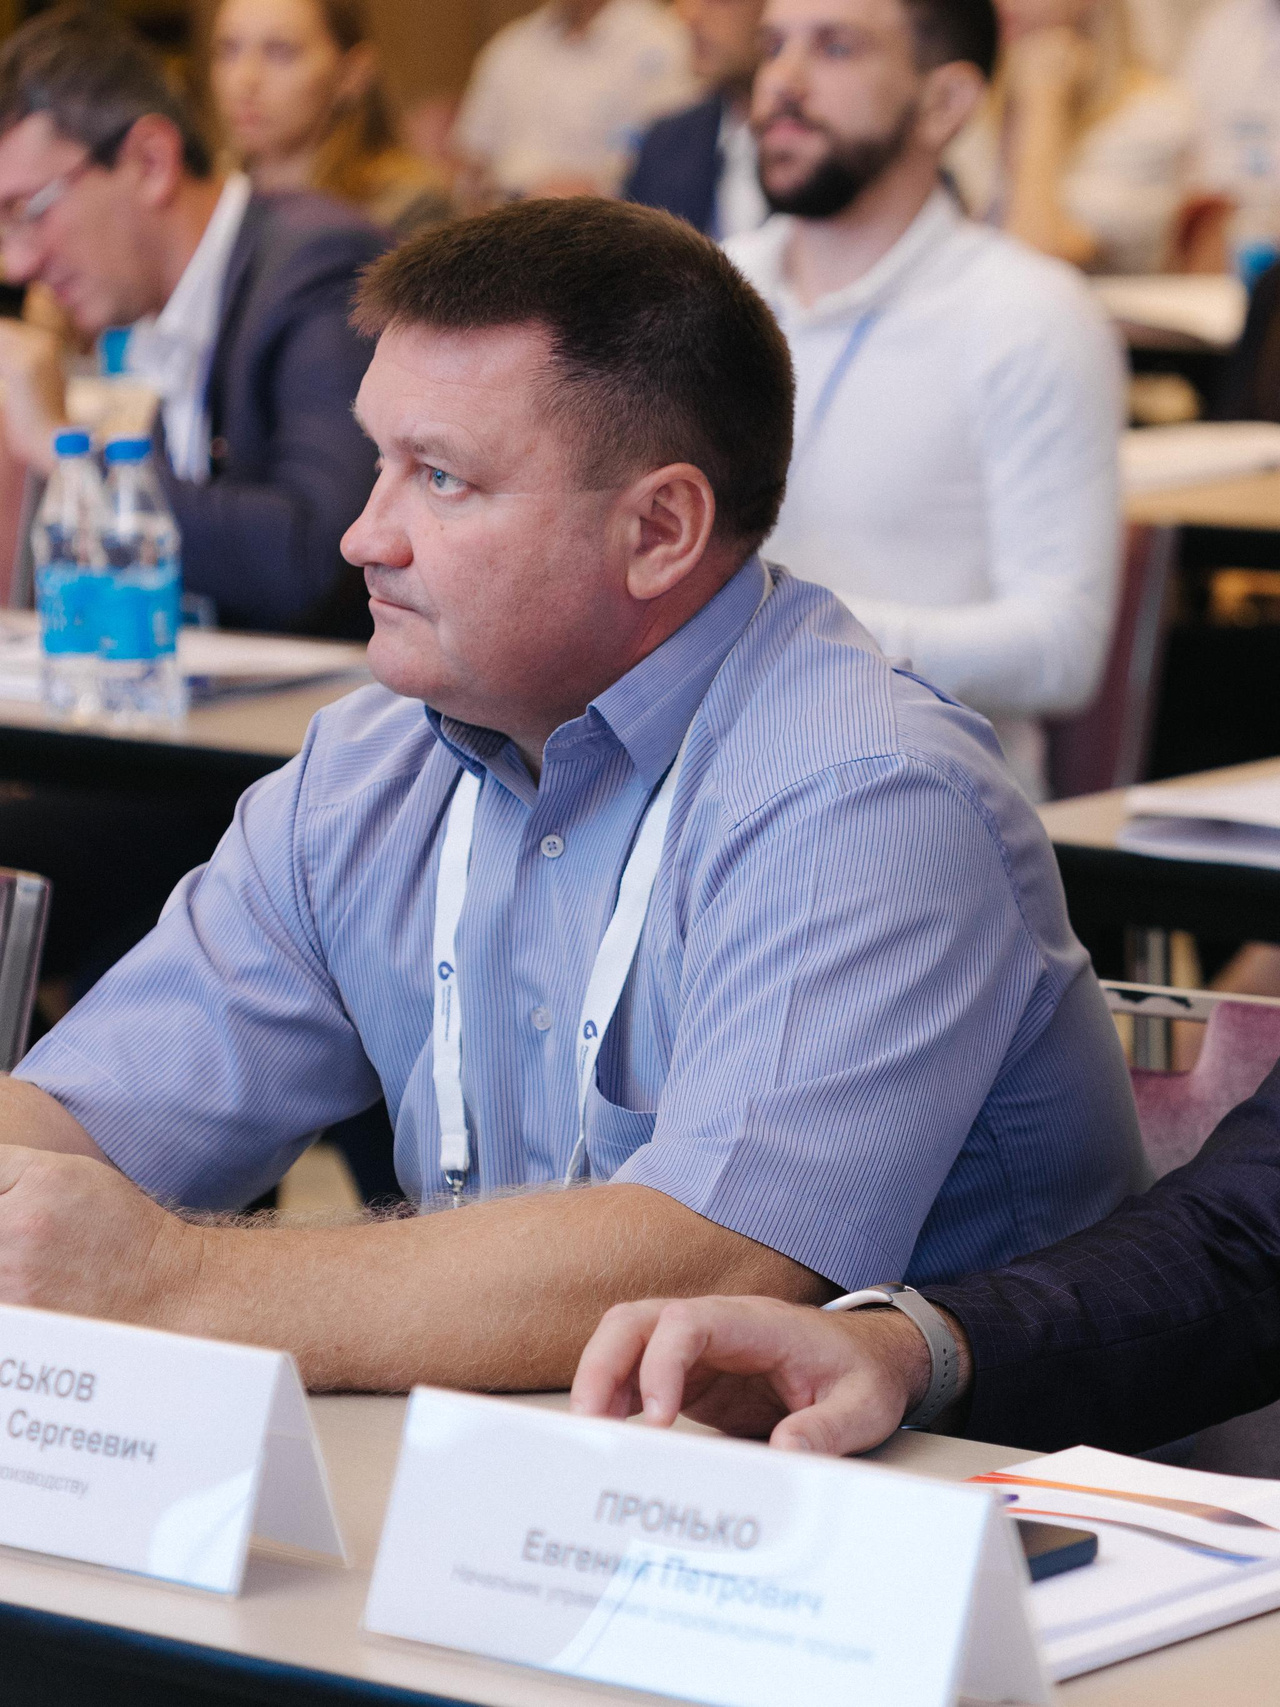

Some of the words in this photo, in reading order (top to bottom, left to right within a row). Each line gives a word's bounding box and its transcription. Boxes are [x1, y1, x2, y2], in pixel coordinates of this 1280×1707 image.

[8, 1409, 156, 1463] Сергеевич
[596, 1489, 762, 1551] ПРОНЬКО
[662, 1554, 823, 1616] Петрович
